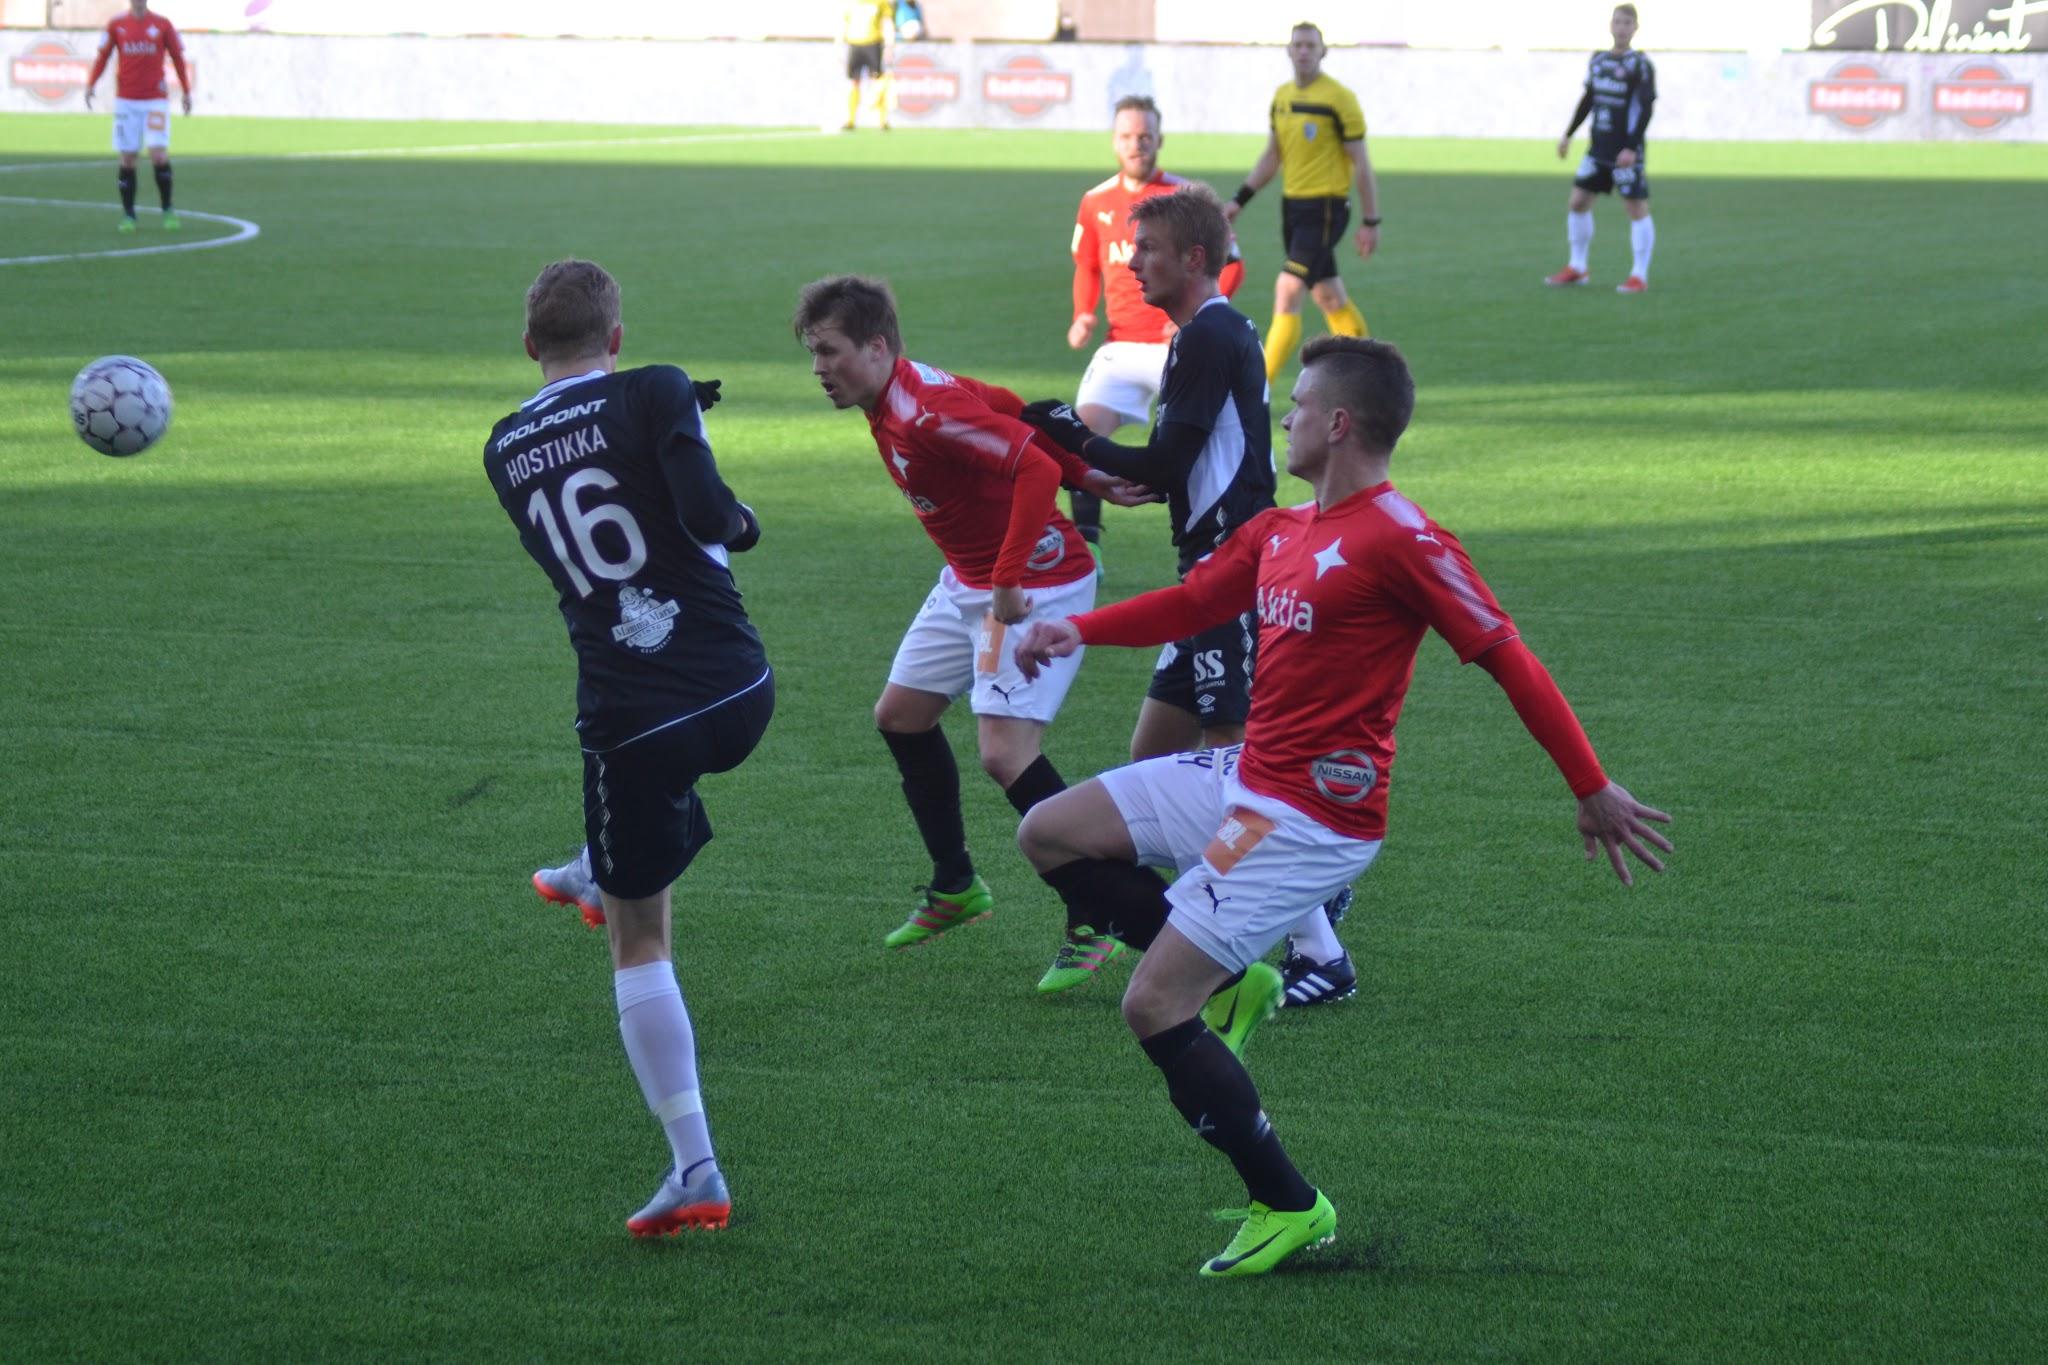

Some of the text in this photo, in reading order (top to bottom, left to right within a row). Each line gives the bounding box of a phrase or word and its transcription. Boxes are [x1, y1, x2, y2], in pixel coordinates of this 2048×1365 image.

[1815, 87, 1901, 109] RadioCity
[1938, 88, 2025, 111] RadioCity
[505, 424, 608, 488] HOSTIKKA
[527, 467, 648, 599] 16
[649, 604, 676, 622] Maria
[1256, 586, 1313, 632] Aktia
[1193, 649, 1225, 682] SS
[1317, 763, 1373, 784] NISSAN
